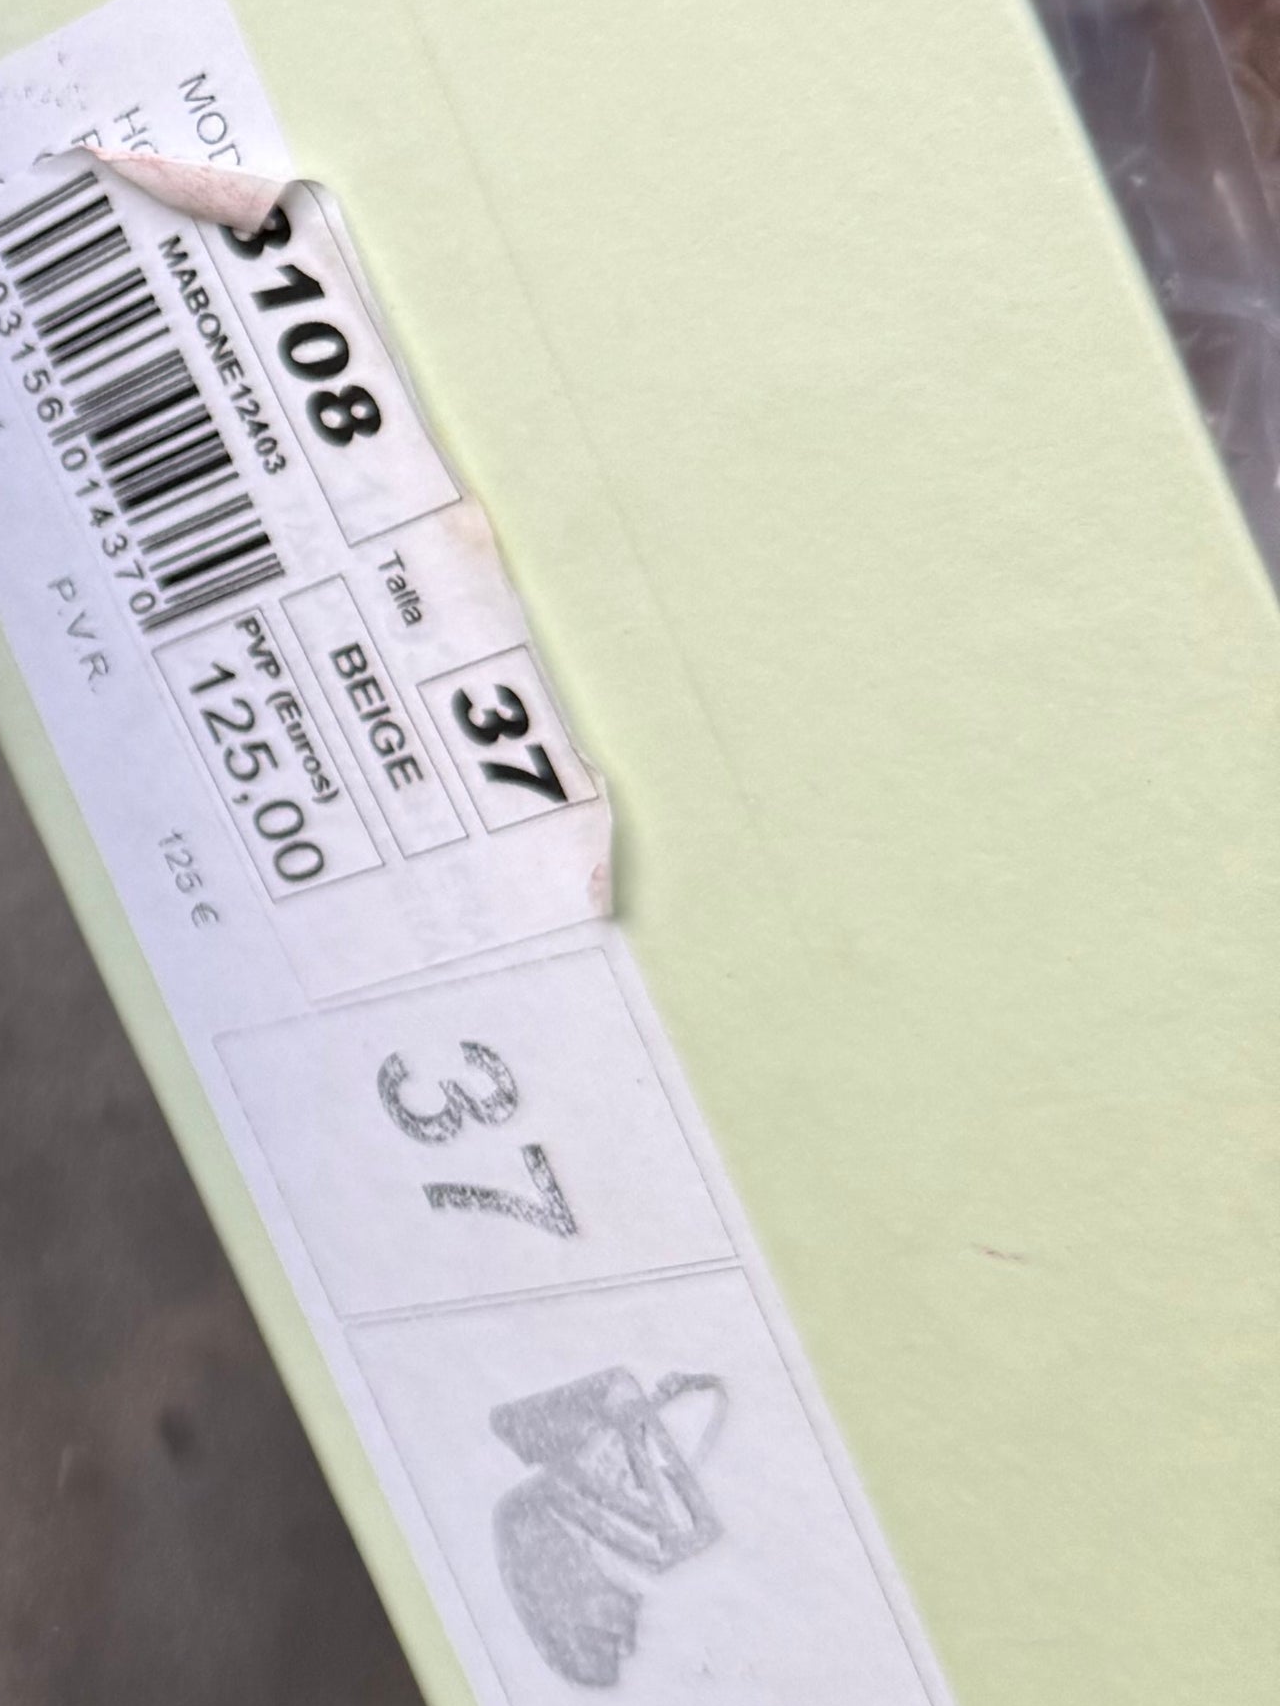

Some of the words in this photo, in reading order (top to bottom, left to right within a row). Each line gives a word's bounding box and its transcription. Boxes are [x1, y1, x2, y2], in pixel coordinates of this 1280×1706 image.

[157, 234, 287, 475] MABONE12403
[60, 446, 157, 615] 014370
[378, 550, 424, 628] Talla
[189, 661, 325, 884] 125,00
[235, 615, 281, 680] PVP
[265, 690, 340, 806] (Euros)
[329, 642, 424, 791] BEIGE
[452, 683, 568, 803] 37
[155, 829, 205, 896] 125
[190, 901, 220, 929] €
[377, 1040, 580, 1239] 37
